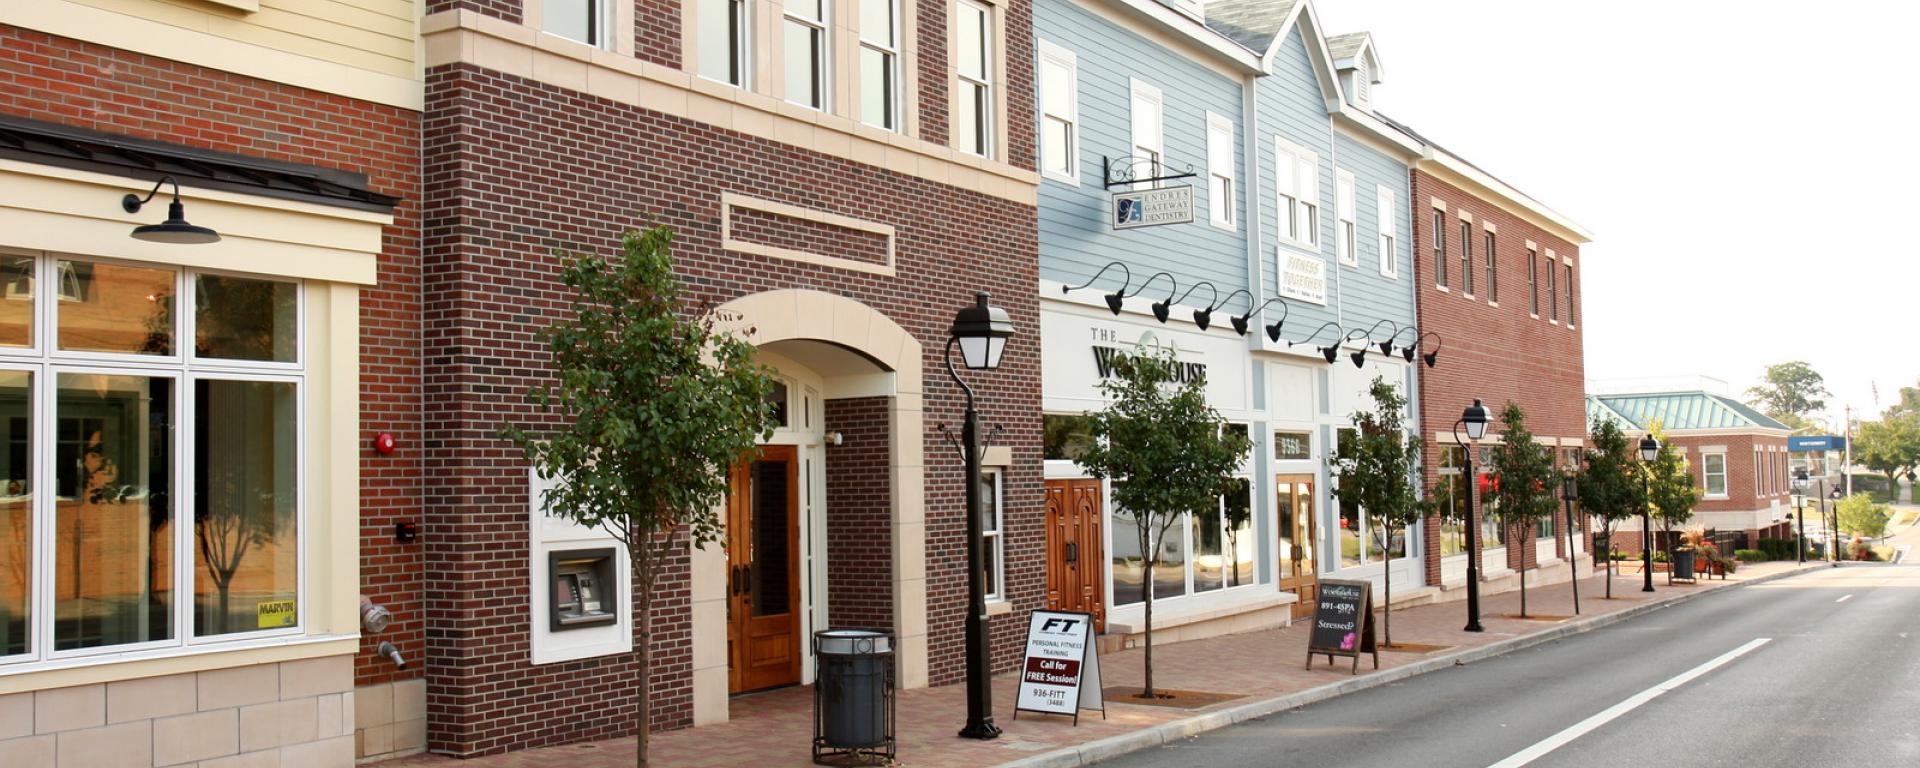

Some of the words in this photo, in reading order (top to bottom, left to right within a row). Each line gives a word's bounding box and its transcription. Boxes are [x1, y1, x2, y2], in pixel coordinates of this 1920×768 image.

[1144, 200, 1189, 212] GATEWAY
[1145, 211, 1189, 222] DENTISTRY
[1091, 327, 1117, 342] THE
[259, 602, 294, 614] MARVIN
[1041, 617, 1080, 633] FT
[1032, 639, 1059, 648] PERSONAL
[1061, 641, 1082, 649] FITNESS
[1043, 649, 1069, 657] TRAINING
[1040, 660, 1055, 669] Call
[1055, 661, 1067, 670] for
[1026, 673, 1046, 681] FREE
[1046, 673, 1078, 685] Session!
[1033, 689, 1066, 699] 936-FITT
